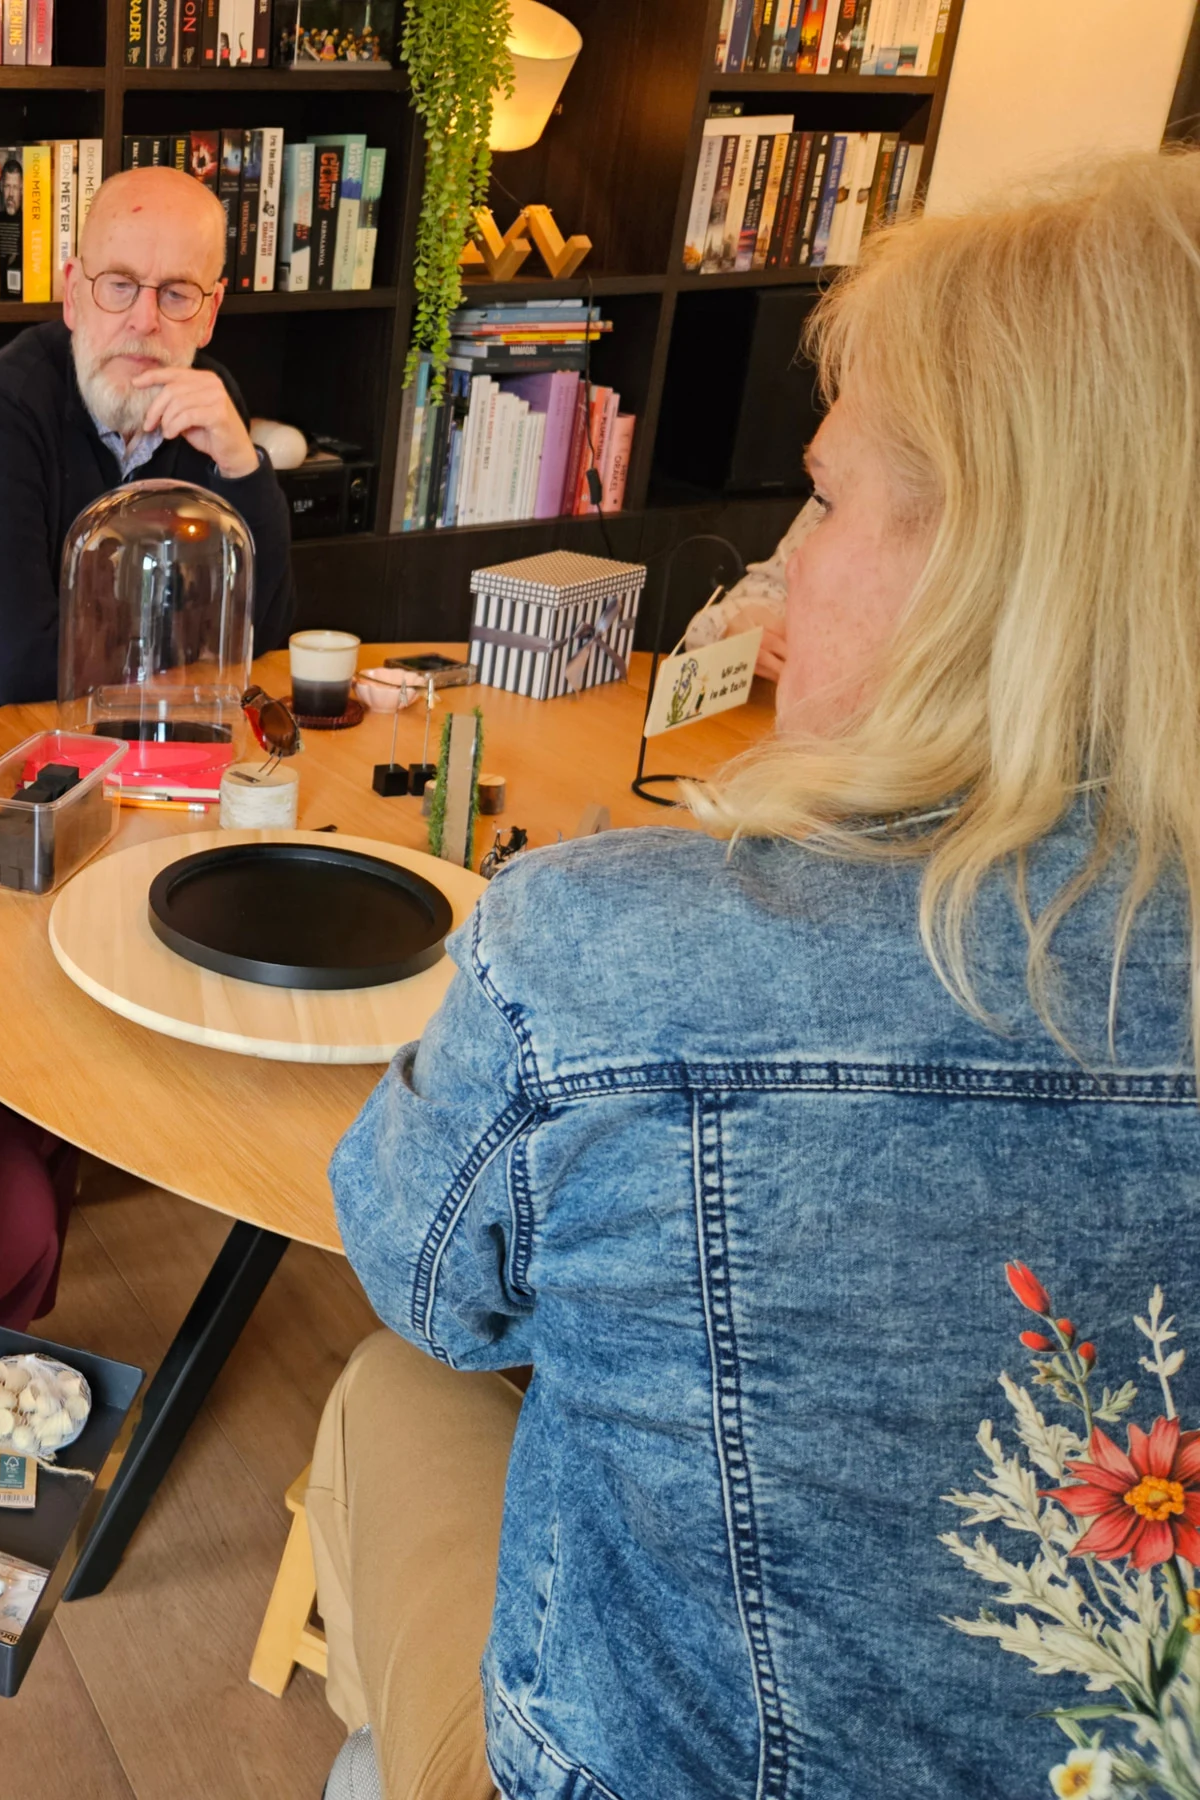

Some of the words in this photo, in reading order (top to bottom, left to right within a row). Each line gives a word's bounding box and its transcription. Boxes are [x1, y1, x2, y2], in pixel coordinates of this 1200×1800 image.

[157, 20, 167, 44] GOD
[936, 12, 949, 34] VOS
[61, 146, 71, 180] DEON
[86, 146, 95, 178] DEON
[724, 138, 736, 164] DANIEL
[742, 139, 752, 165] DANIEL
[757, 139, 768, 166] DANIEL
[775, 138, 785, 162] DANIEL
[832, 139, 842, 166] DANIEL
[32, 153, 41, 179] DEON
[722, 166, 731, 187] SILVA
[738, 168, 747, 187] SILVA
[772, 165, 781, 189] SILVA
[829, 169, 838, 189] SILVA
[318, 152, 338, 211] CLANCY
[754, 170, 763, 191] SILVA
[32, 180, 41, 221] MEYER
[61, 182, 71, 233] MEYER
[31, 230, 43, 274] LEEUW
[317, 219, 328, 267] KERNAANVAL
[609, 455, 621, 492] ORAKEL
